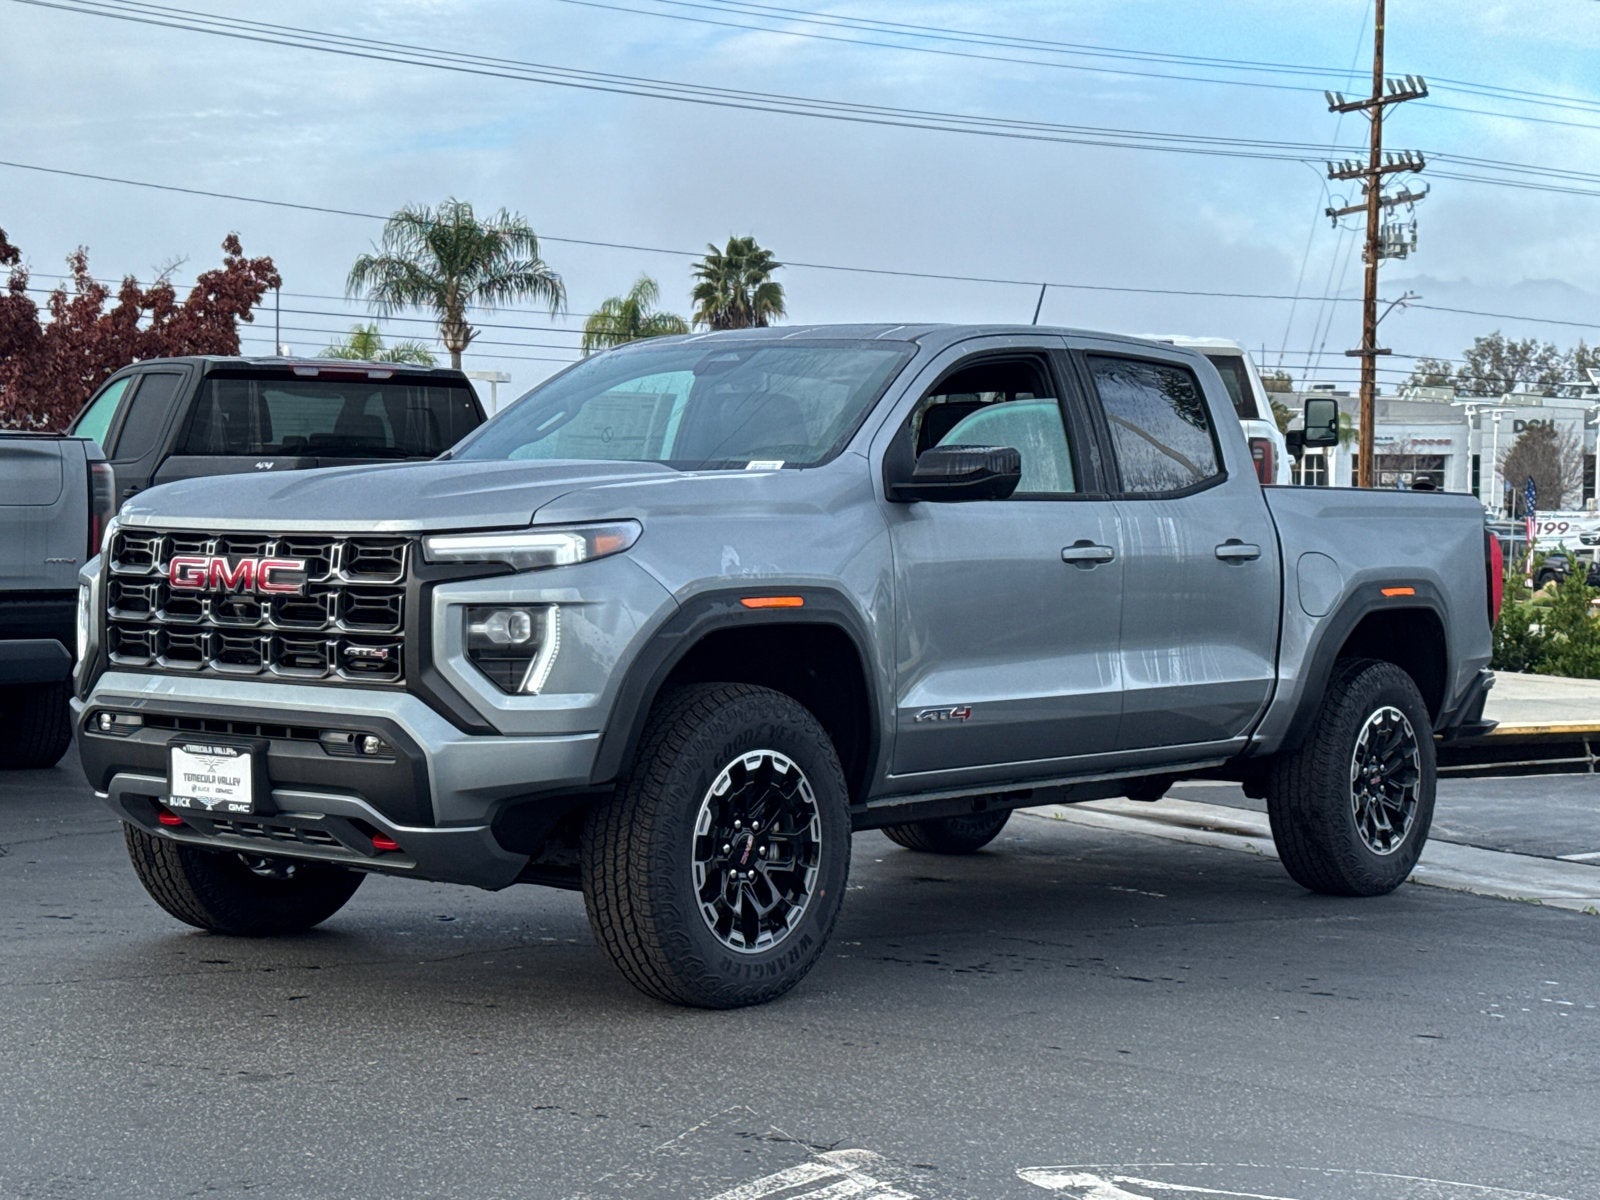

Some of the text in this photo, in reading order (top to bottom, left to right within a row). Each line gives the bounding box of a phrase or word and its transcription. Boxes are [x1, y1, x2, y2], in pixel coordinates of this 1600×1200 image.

[1536, 521, 1570, 535] 199
[169, 556, 306, 594] GMC
[183, 772, 241, 786] TEMECULA VALLEY
[170, 797, 250, 813] BUICK GMC
